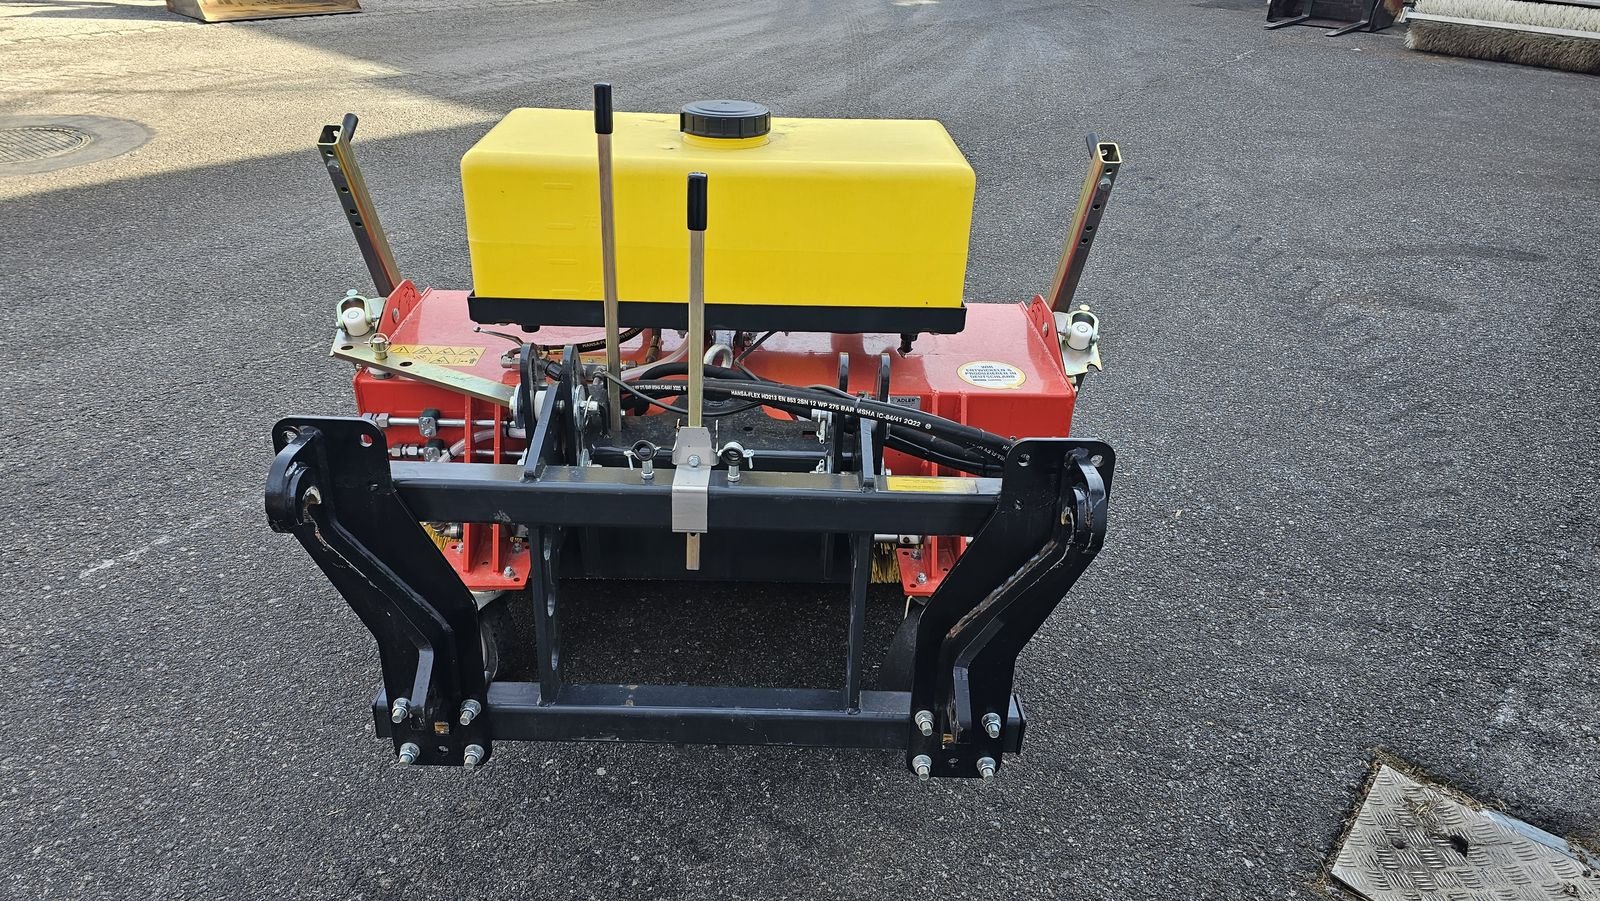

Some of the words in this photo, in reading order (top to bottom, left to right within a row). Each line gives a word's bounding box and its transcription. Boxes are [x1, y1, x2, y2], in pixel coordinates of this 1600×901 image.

[730, 390, 761, 399] HANSA-FLEX
[840, 405, 855, 413] BAR
[856, 408, 875, 417] MSHA
[903, 418, 921, 427] 2Q22
